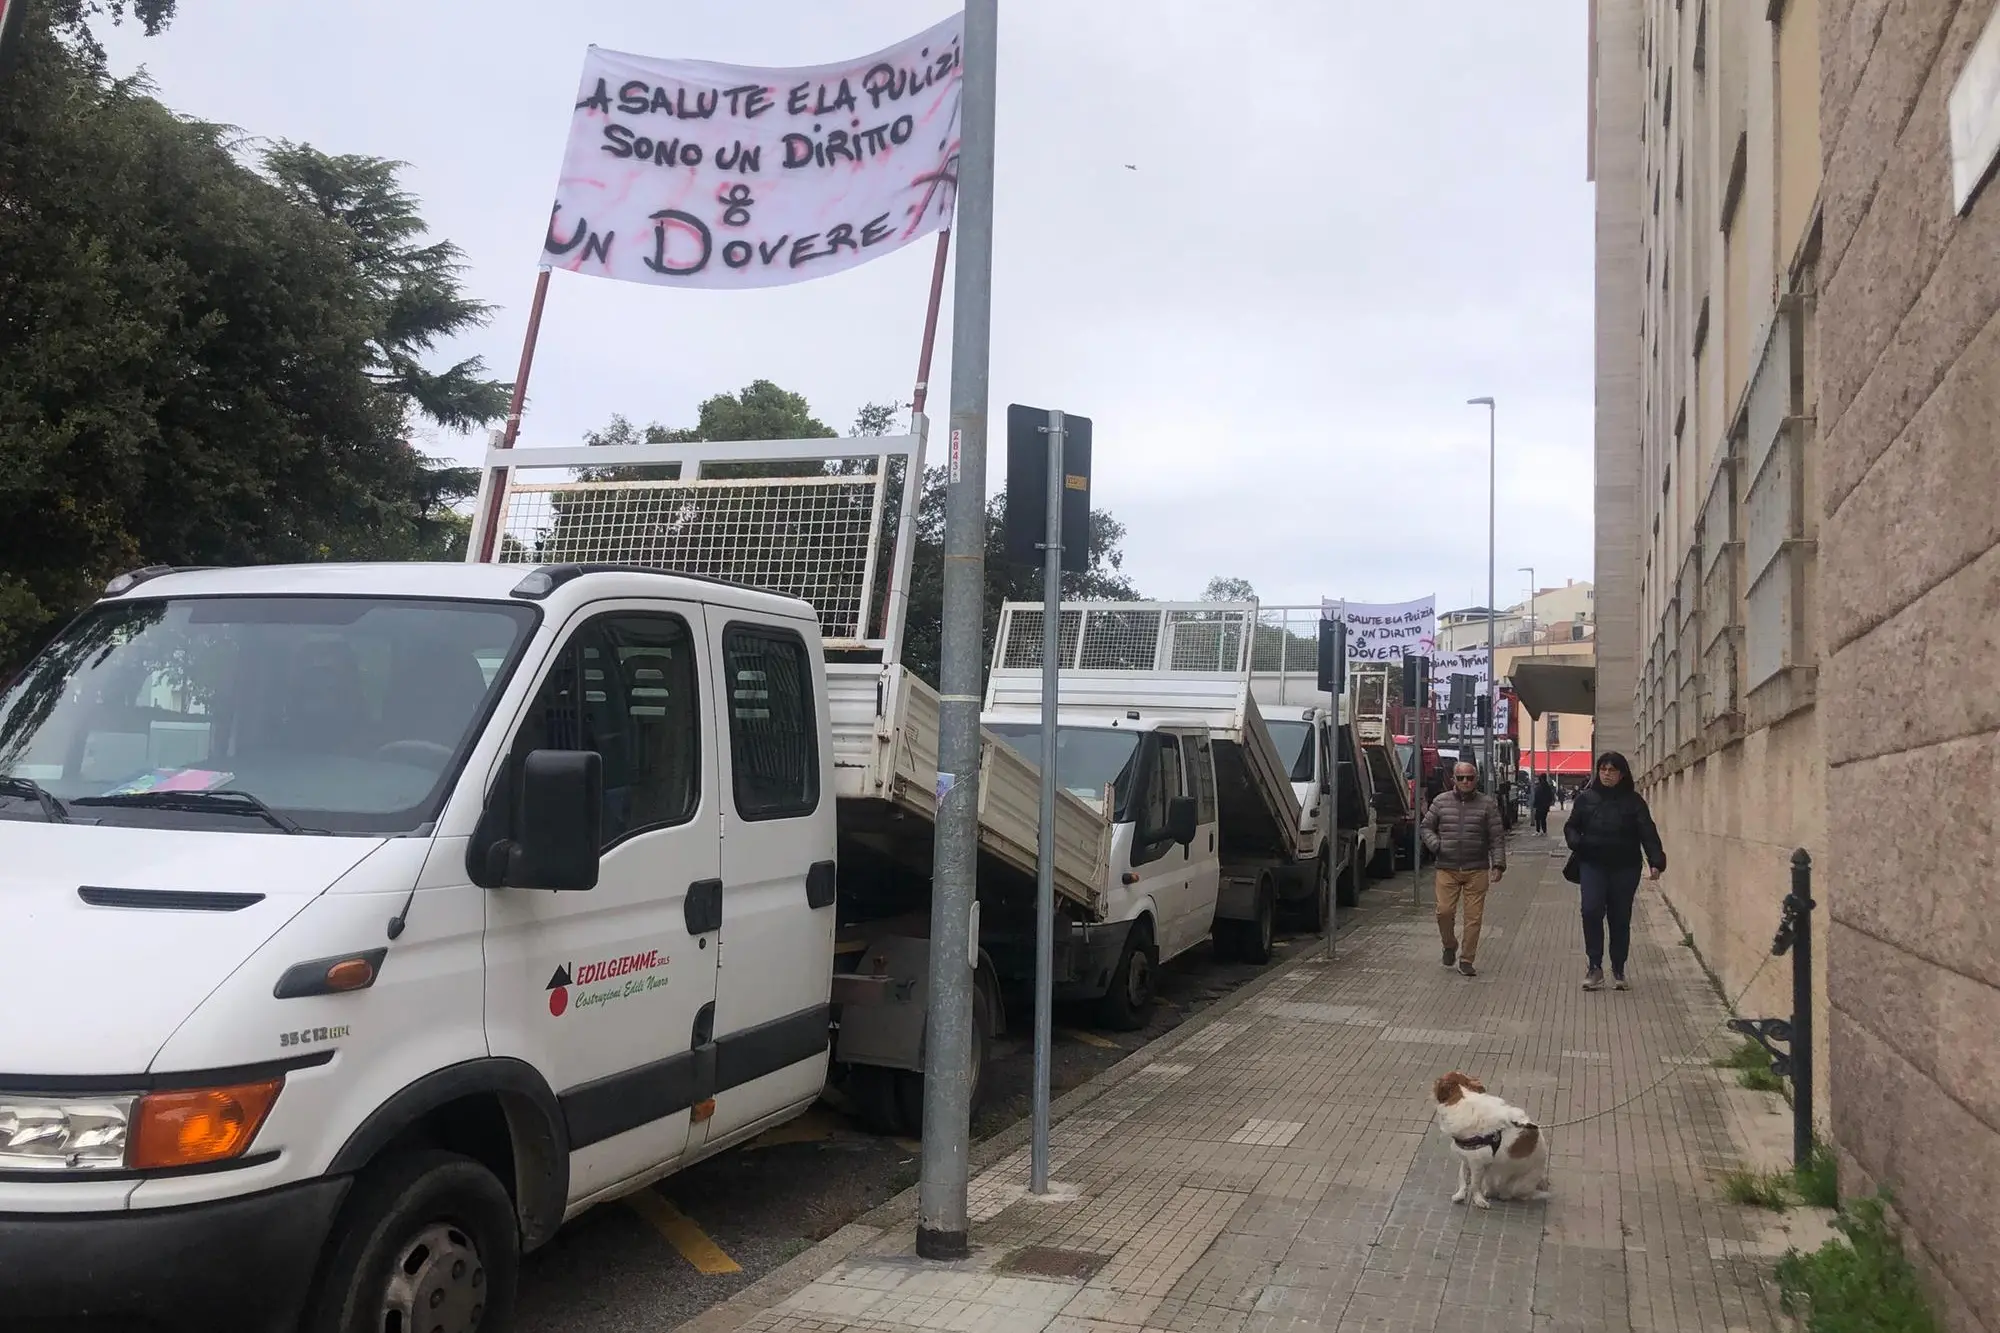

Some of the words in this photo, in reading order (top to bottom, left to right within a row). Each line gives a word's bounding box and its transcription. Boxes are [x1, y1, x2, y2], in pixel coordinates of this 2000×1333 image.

[575, 78, 613, 115] A
[617, 80, 776, 119] SALUTE
[601, 124, 704, 167] SONO
[715, 140, 760, 173] UN
[545, 200, 614, 264] UN
[643, 209, 897, 276] DOVERE
[1347, 613, 1382, 625] SALUTE
[1362, 630, 1375, 639] UN
[1347, 644, 1416, 660] DOVERE
[577, 950, 658, 986] EDILGIEMME
[576, 991, 620, 1008] Costruzioni
